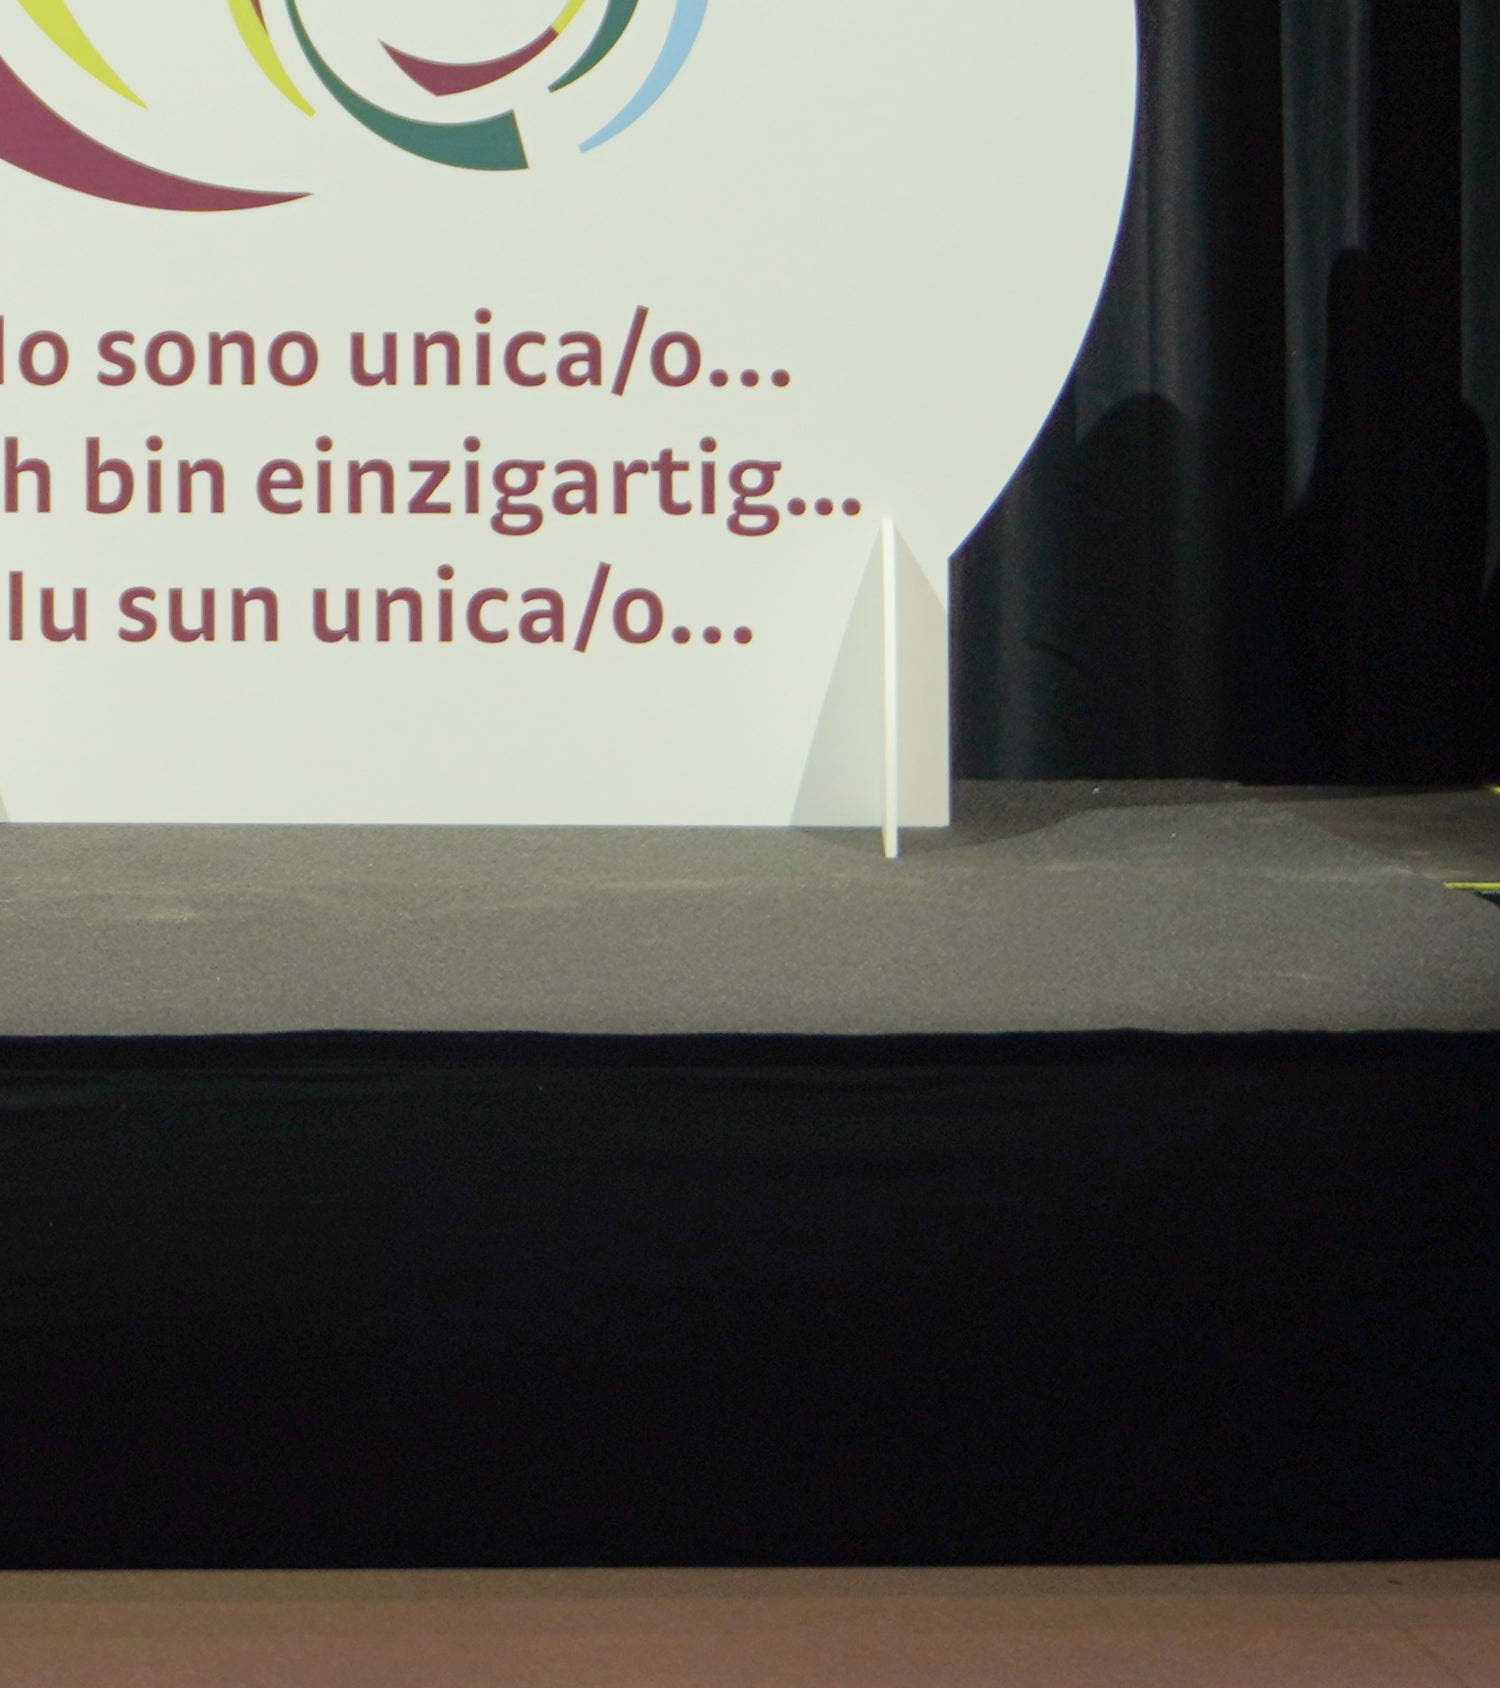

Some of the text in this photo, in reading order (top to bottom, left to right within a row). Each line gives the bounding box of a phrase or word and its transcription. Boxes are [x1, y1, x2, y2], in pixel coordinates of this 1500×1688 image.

[97, 330, 319, 388] sono
[350, 305, 791, 396] unica/o...
[85, 437, 226, 515] bin
[256, 437, 862, 538] einzigartig...
[8, 563, 754, 653] Iu sun unica/o...
